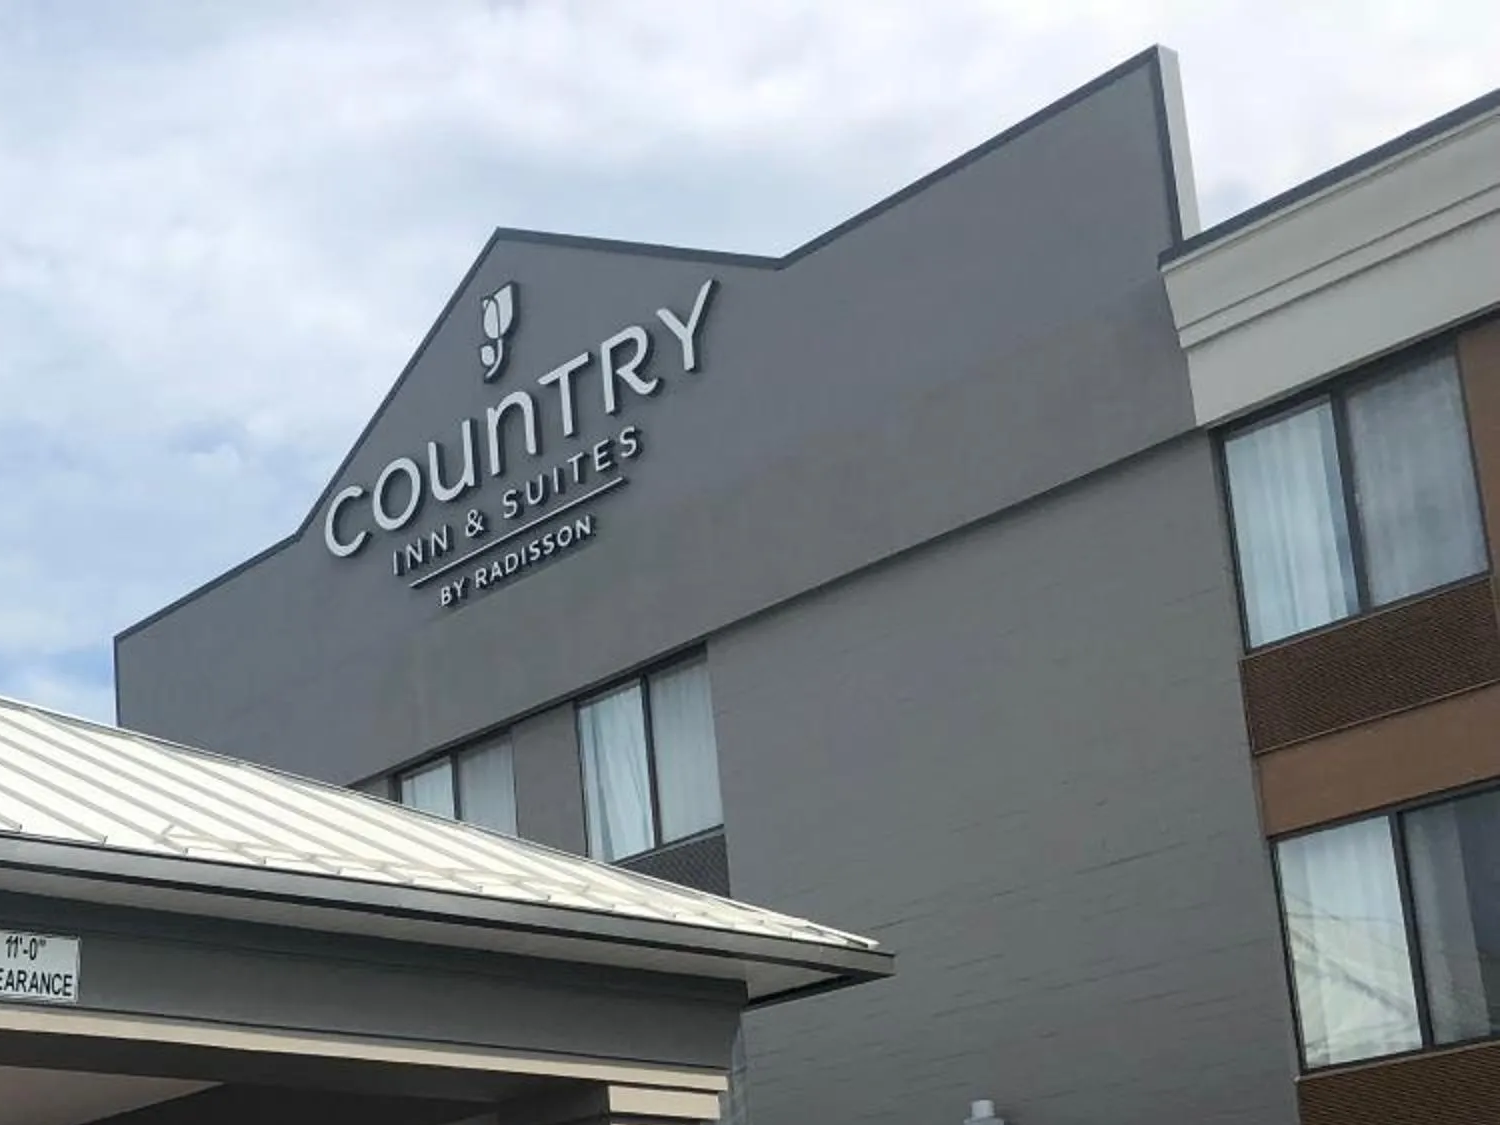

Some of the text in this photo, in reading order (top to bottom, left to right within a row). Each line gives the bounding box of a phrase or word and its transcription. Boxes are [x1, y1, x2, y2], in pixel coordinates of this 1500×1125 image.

[393, 425, 638, 575] INN & SUITES
[440, 515, 592, 605] BY RADISSON
